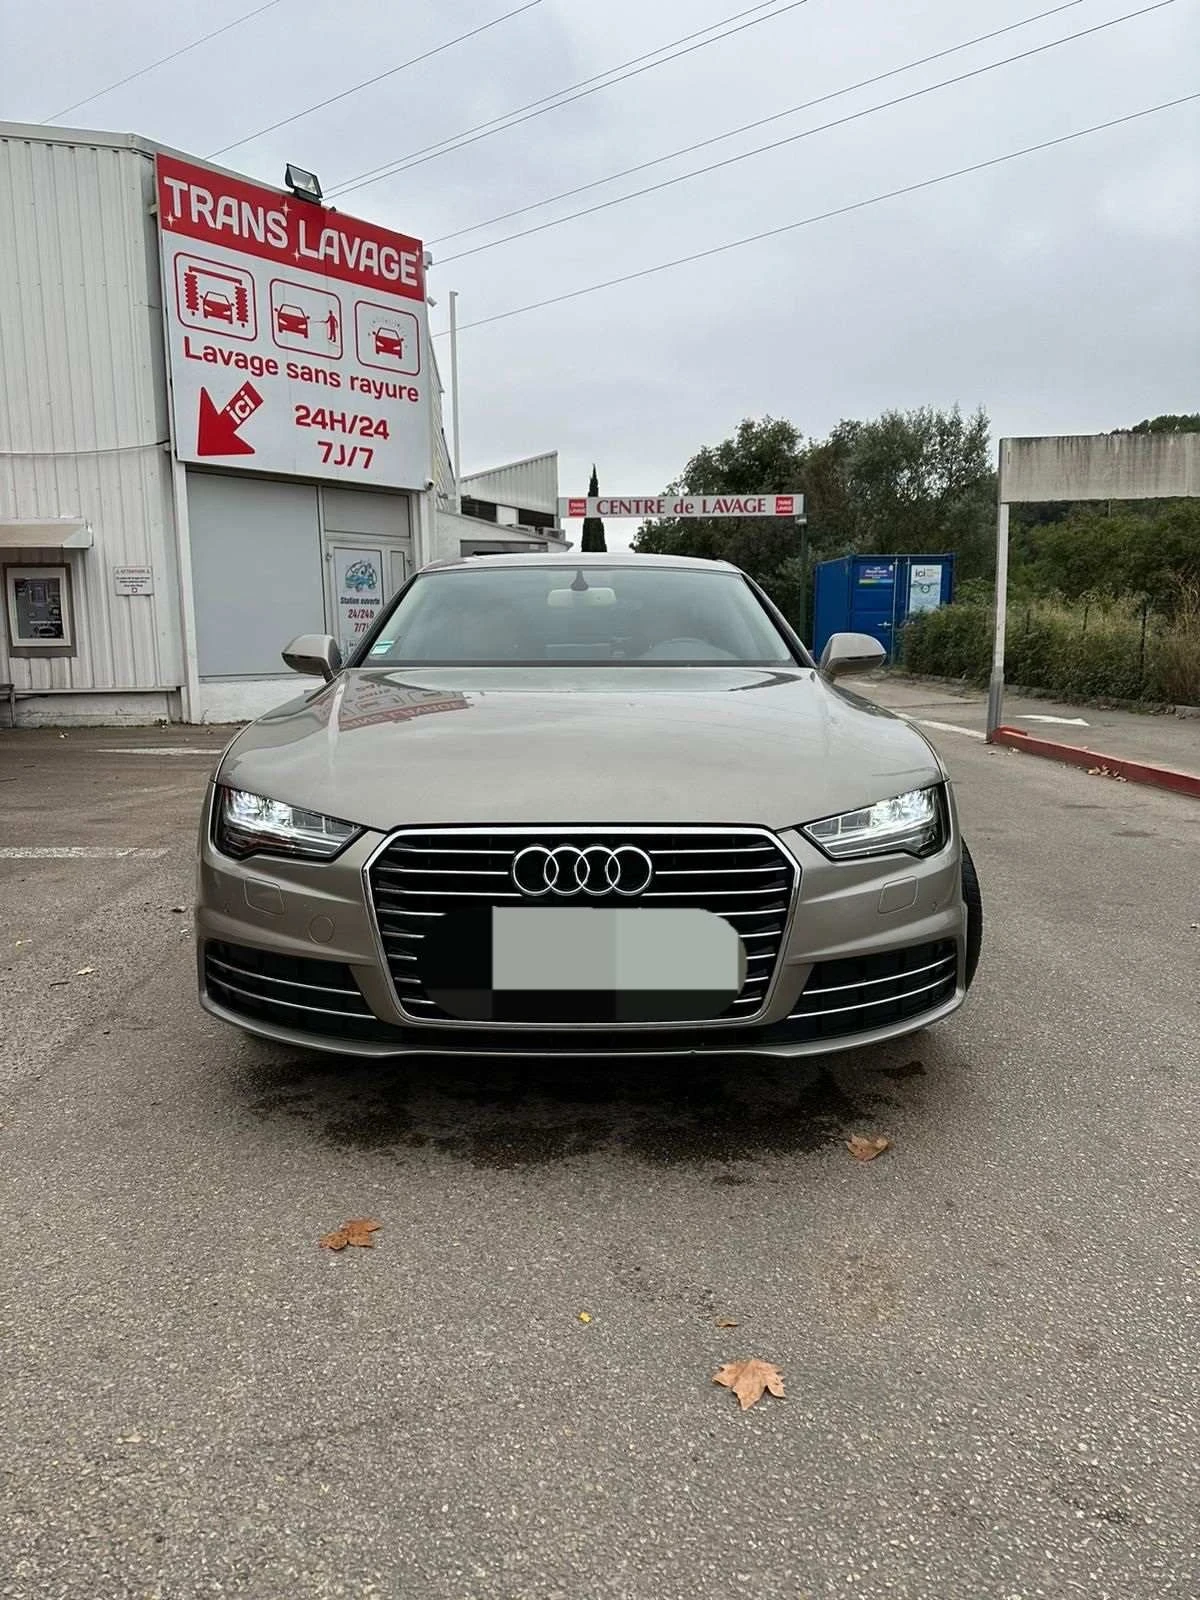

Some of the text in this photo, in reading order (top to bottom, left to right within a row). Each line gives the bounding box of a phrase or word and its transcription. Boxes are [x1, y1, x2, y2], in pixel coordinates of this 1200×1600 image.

[164, 176, 418, 287] TRANS LAVAGE
[184, 336, 419, 402] Lavage sans rayure
[226, 390, 256, 425] ici
[295, 405, 390, 440] 24H/24
[317, 441, 374, 469] 7J/7
[596, 497, 766, 515] CENTRE de LAVAGE
